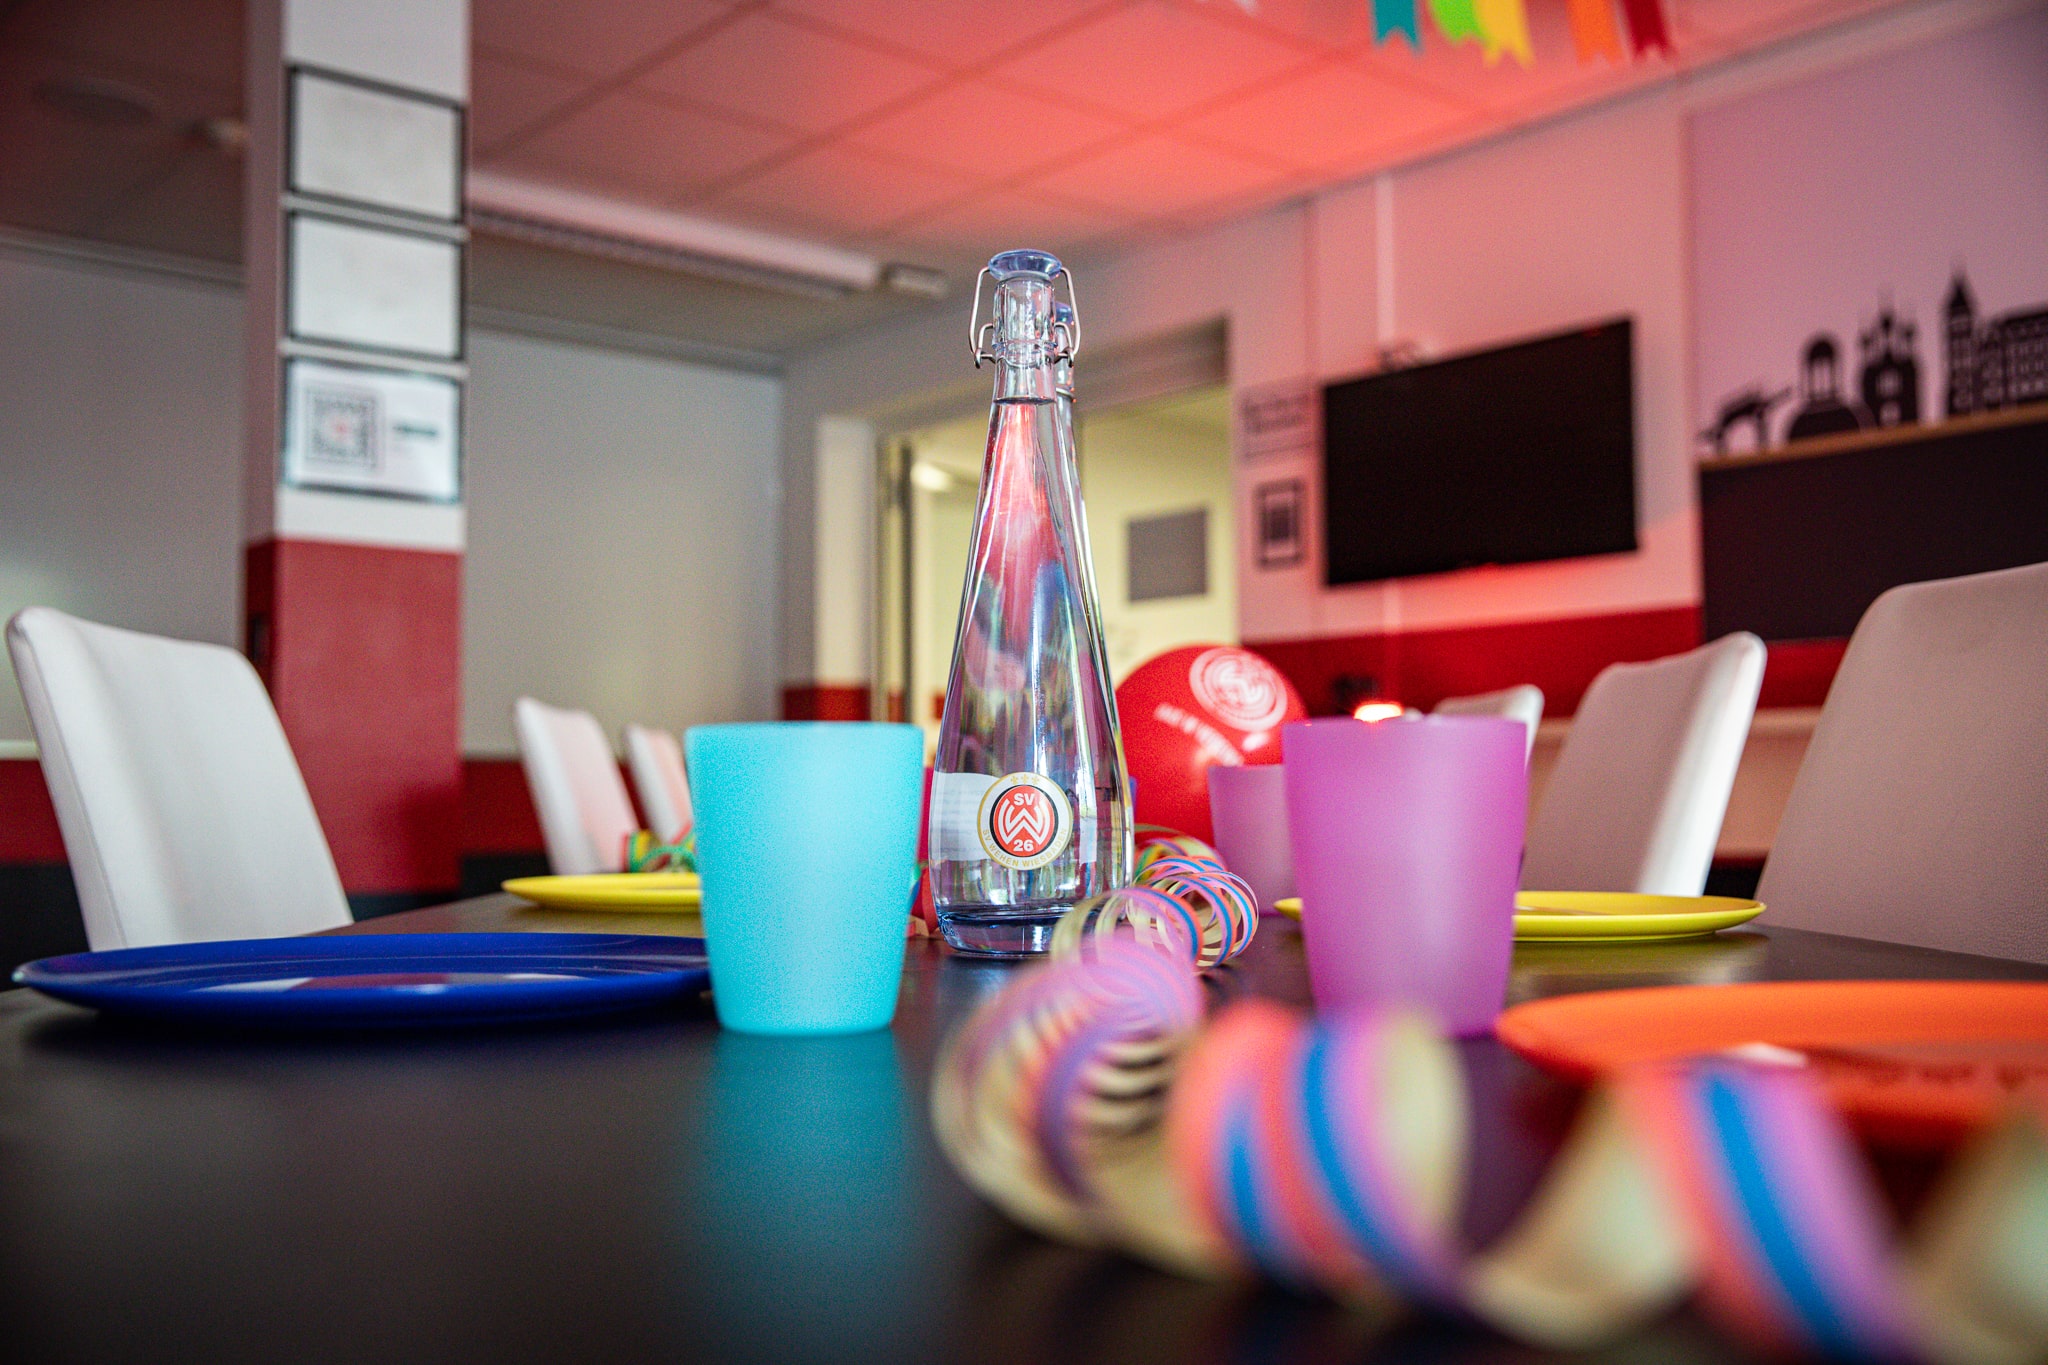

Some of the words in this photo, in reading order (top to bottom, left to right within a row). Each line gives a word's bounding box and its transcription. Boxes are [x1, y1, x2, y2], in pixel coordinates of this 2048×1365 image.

[1013, 793, 1035, 806] SV
[983, 829, 992, 841] SV
[989, 843, 1019, 867] WEHEN
[1022, 828, 1067, 867] WIESBADEN
[1013, 839, 1034, 852] 26
